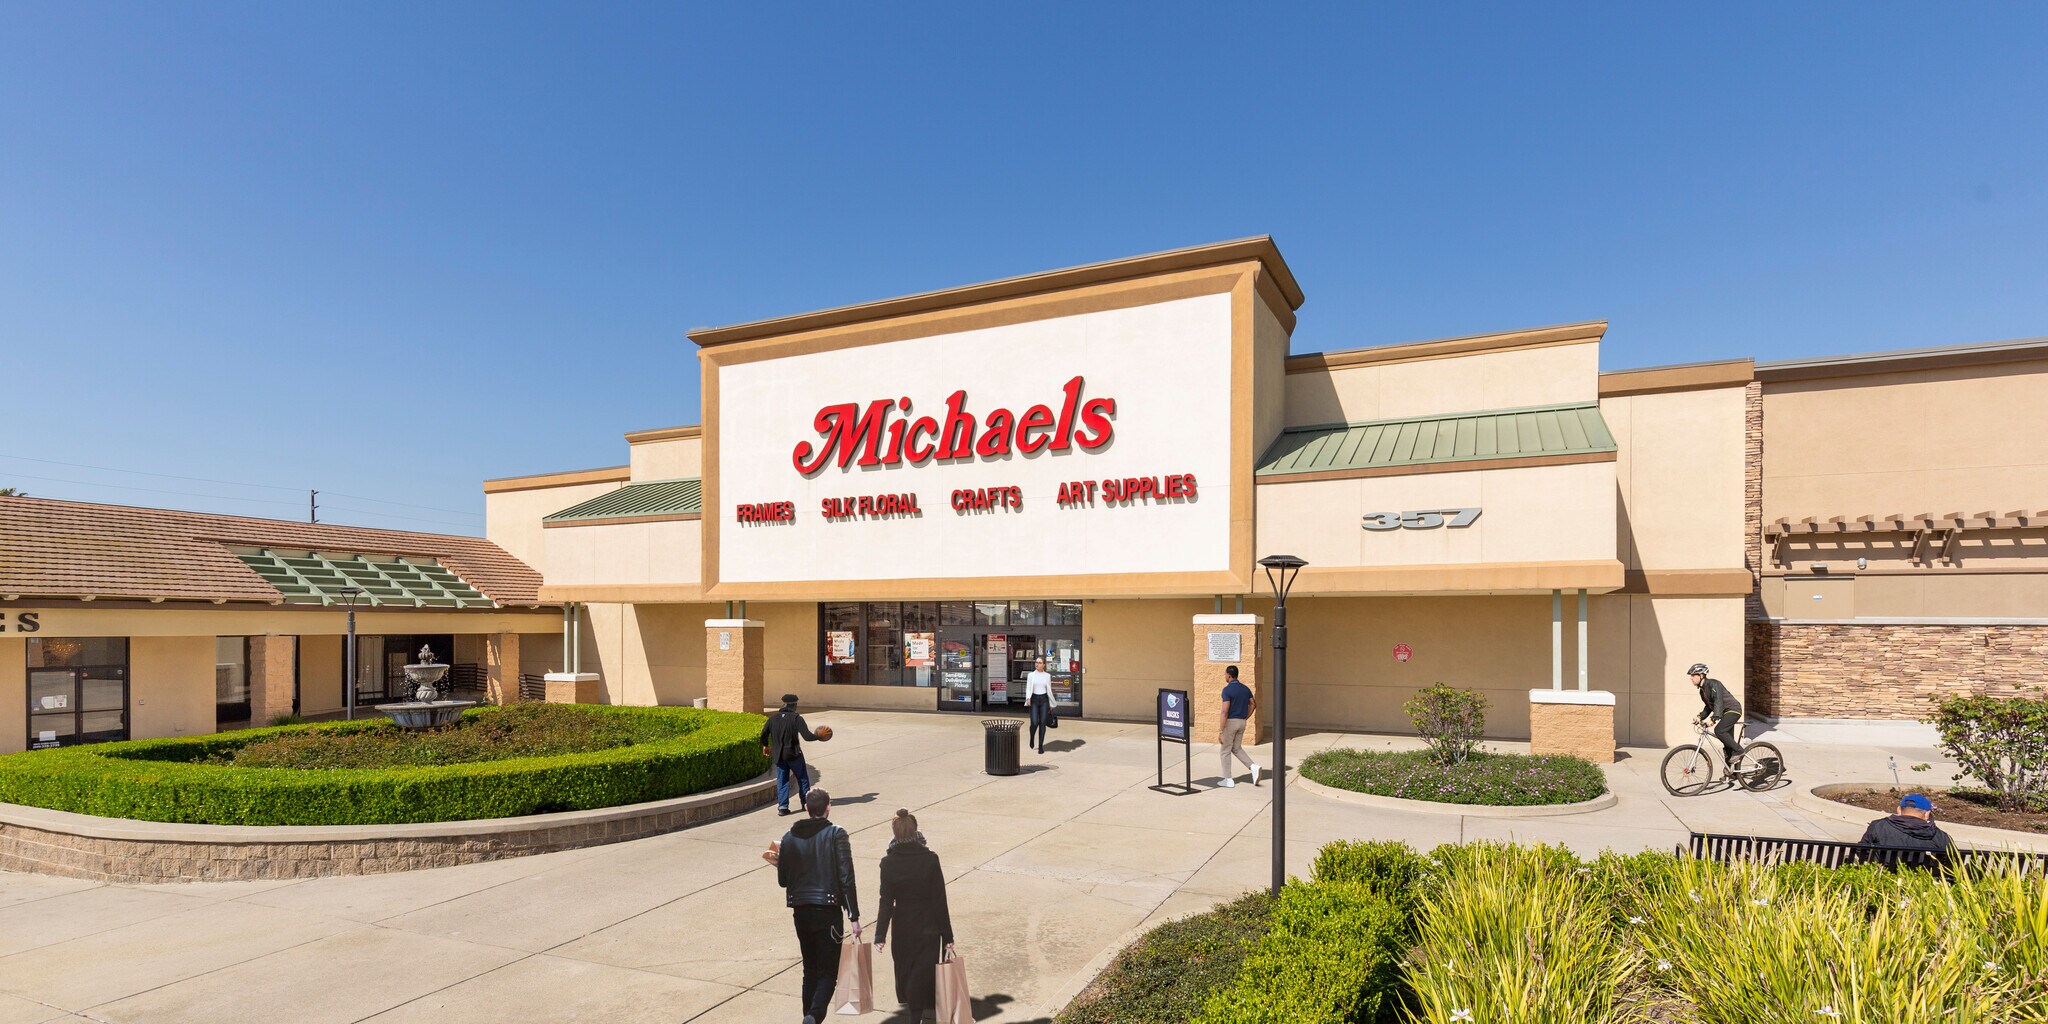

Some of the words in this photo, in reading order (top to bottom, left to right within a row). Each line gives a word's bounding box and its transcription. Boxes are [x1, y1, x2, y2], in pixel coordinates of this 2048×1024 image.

[793, 376, 1115, 474] Michaels
[951, 486, 1021, 511] CRAFTS
[1057, 480, 1096, 504] ART
[1102, 474, 1196, 502] SUPPLIES
[737, 501, 794, 523] FRAMES
[822, 497, 854, 518] SILK
[859, 493, 921, 515] FLORAL
[1361, 508, 1482, 530] 357
